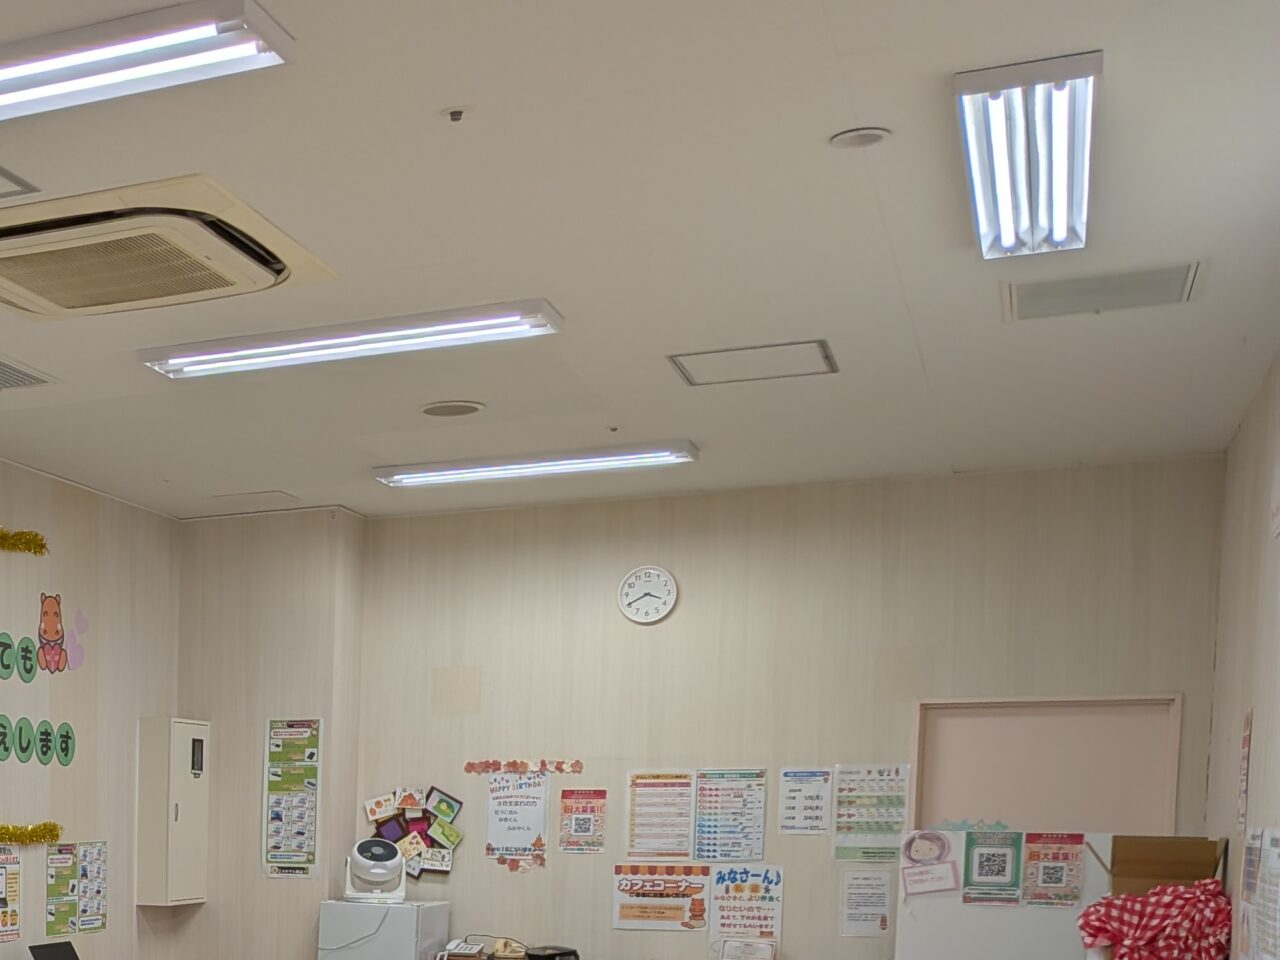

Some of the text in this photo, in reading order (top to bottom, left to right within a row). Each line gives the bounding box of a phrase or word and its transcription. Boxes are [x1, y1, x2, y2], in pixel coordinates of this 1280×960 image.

[716, 868, 773, 885] みなさーん
[618, 879, 704, 892] カフェコーナー
